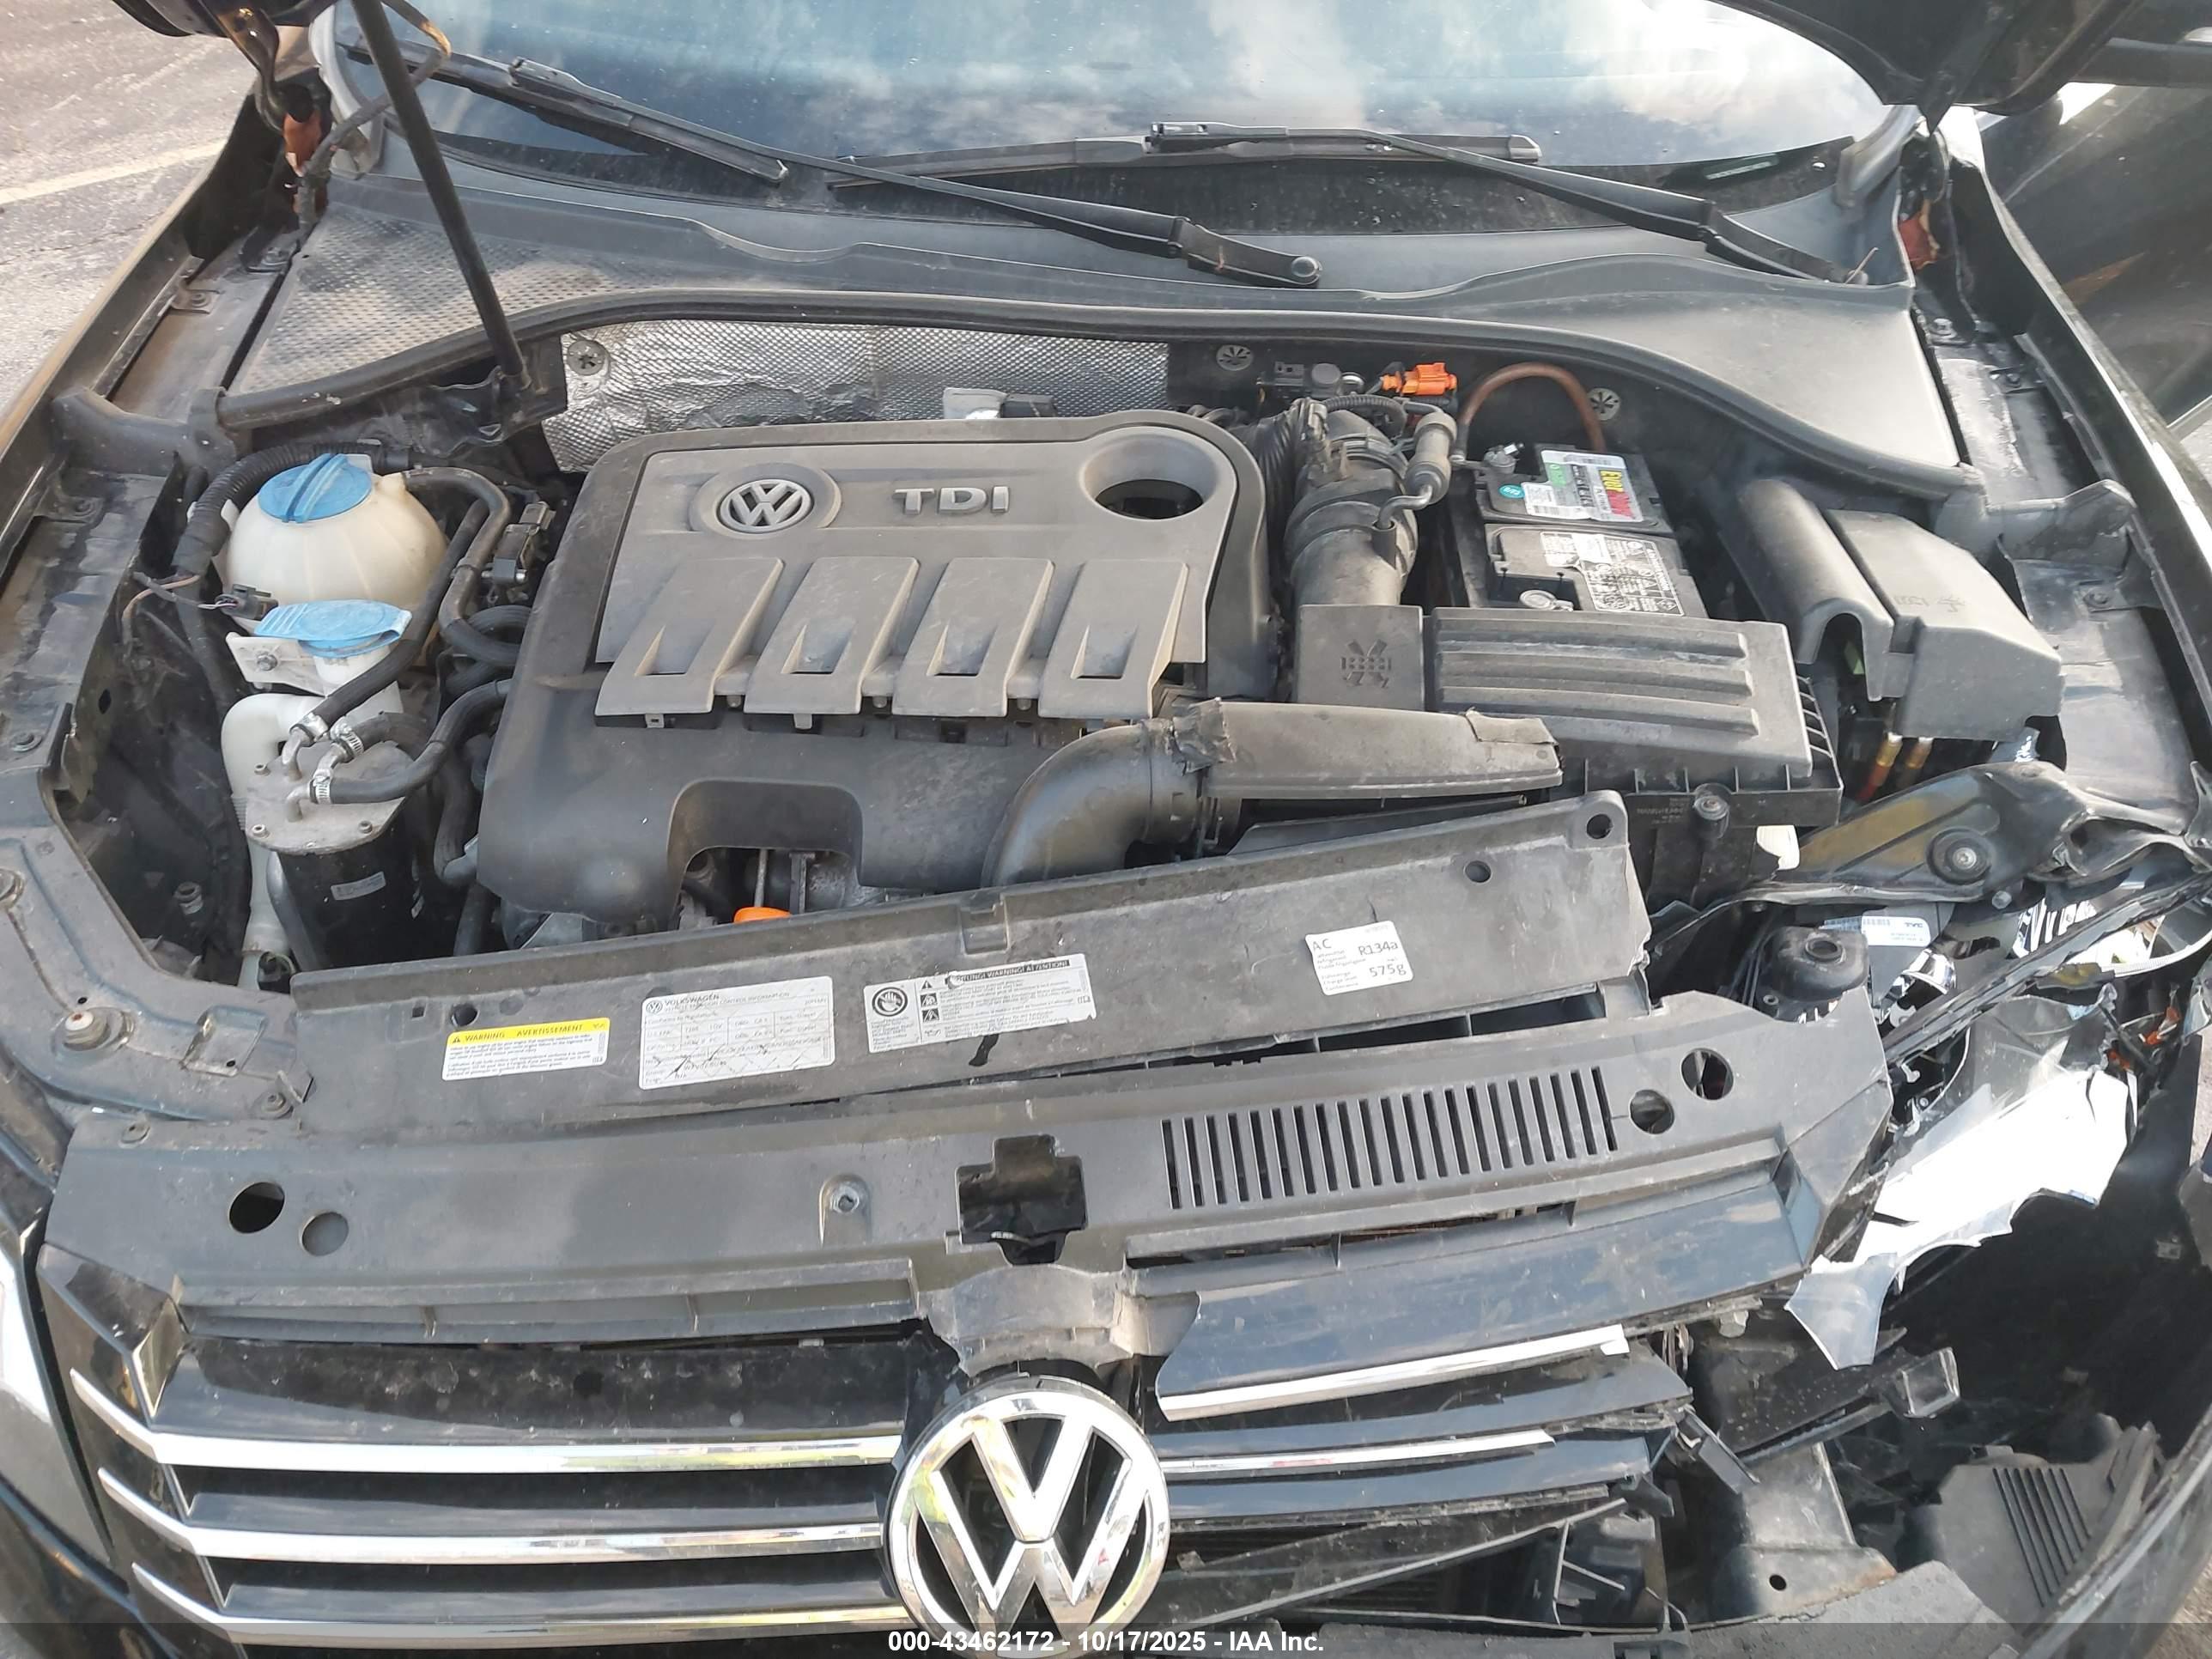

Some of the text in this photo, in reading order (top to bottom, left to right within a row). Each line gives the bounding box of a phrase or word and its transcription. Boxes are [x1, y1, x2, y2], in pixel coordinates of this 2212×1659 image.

[894, 486, 1009, 514] TDI
[1358, 941, 1398, 956] R134a
[988, 966, 1024, 978] WARNING!
[1369, 963, 1407, 977] 575g
[665, 994, 719, 1006] VOLKSWAGEN
[465, 1032, 505, 1042] WARNING
[517, 1024, 583, 1036] AVERTISSEMENT
